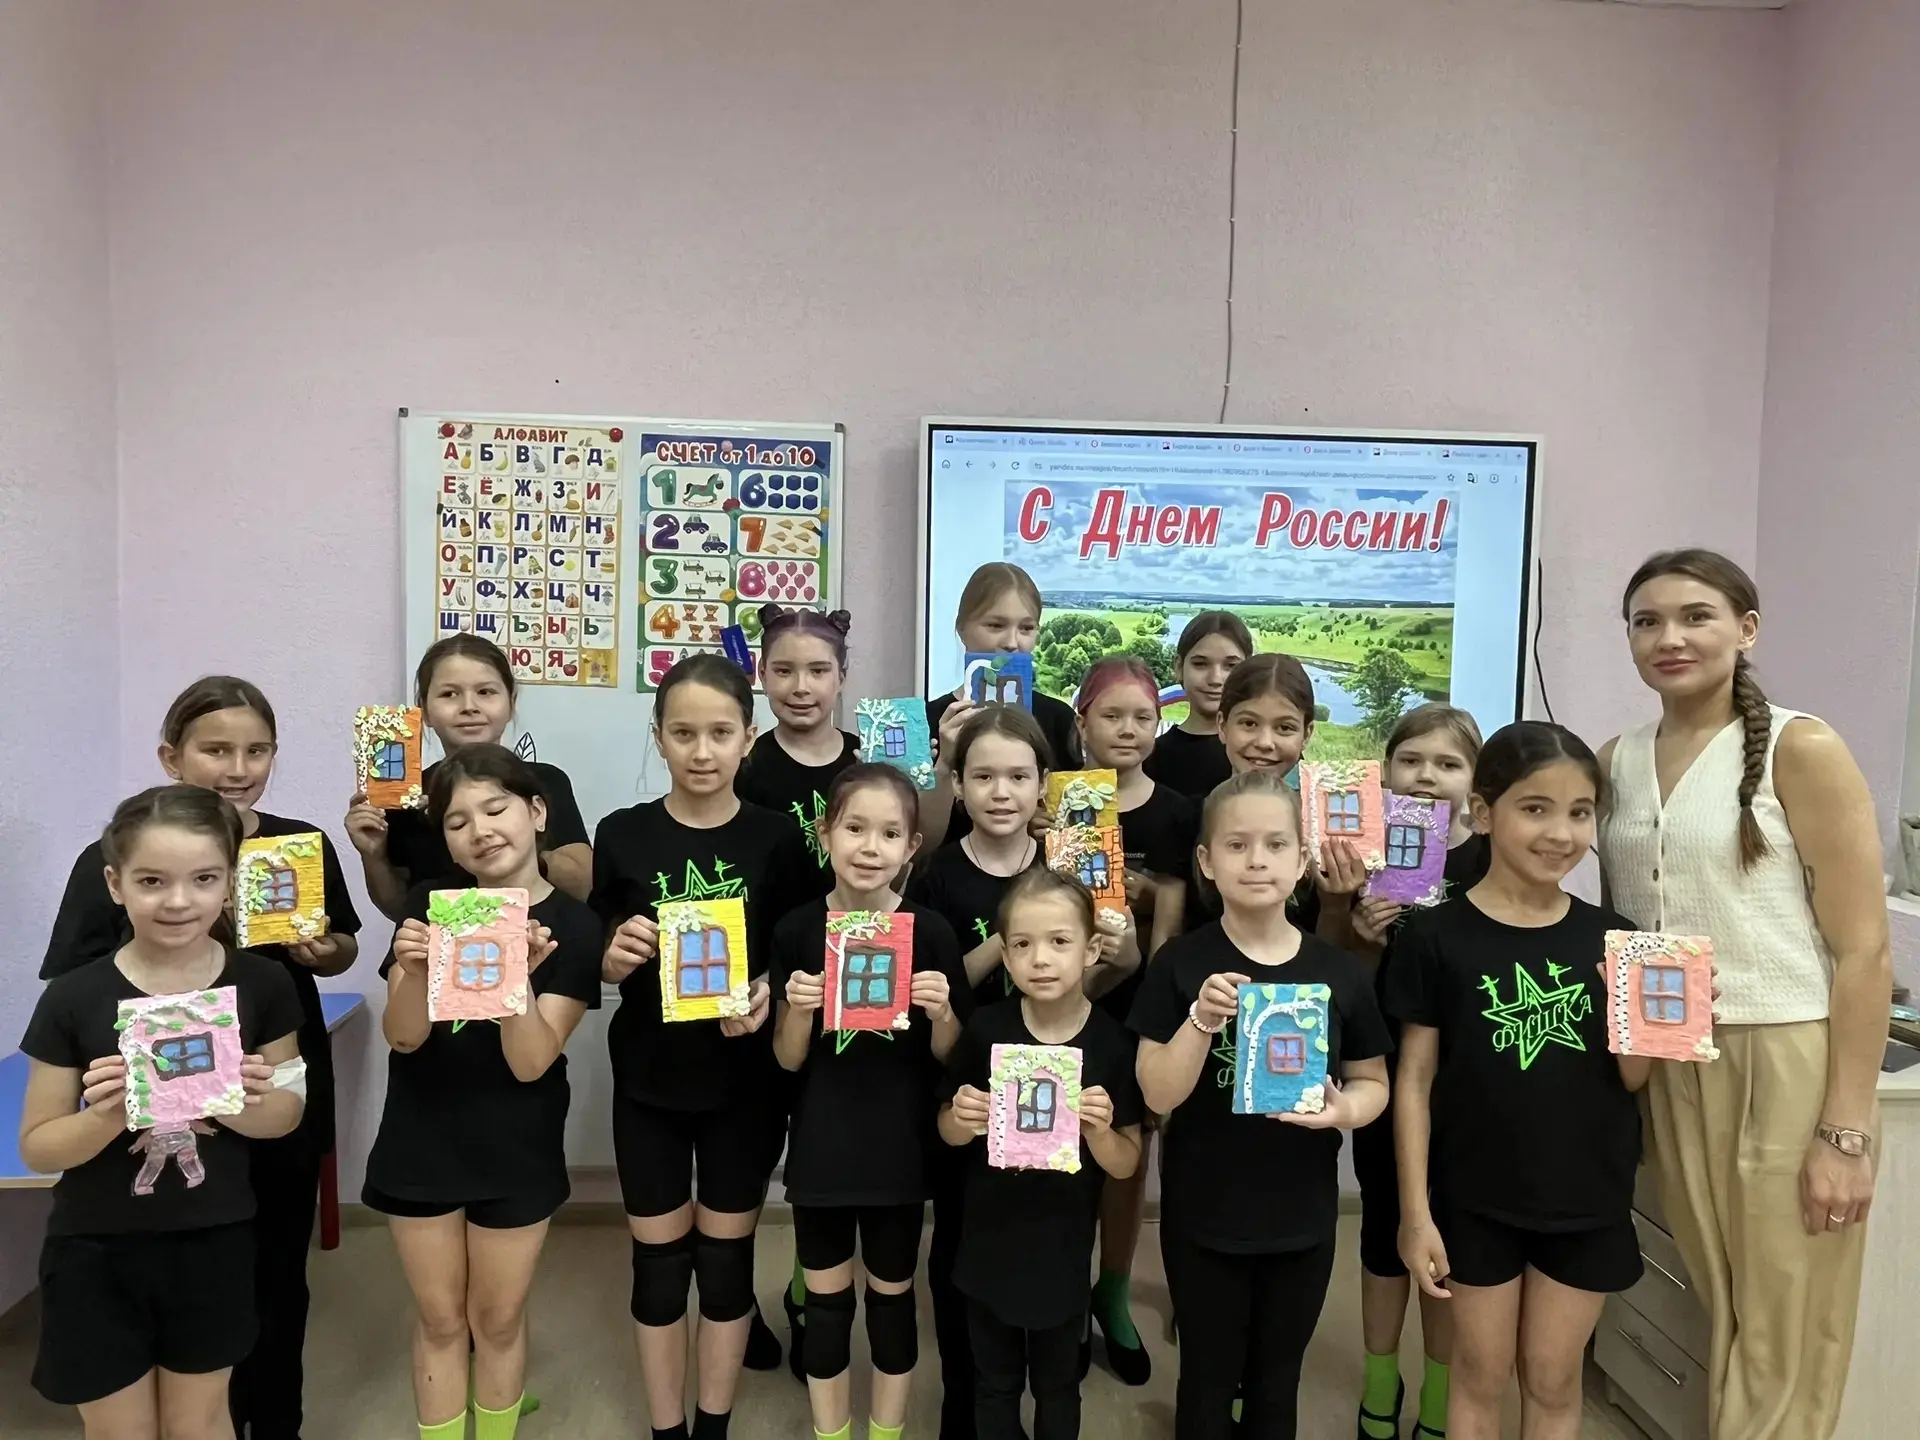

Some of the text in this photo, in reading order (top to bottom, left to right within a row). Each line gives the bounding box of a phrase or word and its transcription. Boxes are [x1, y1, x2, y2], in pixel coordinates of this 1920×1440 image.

[494, 427, 568, 443] АЛФАВИТ
[444, 442, 603, 466] А Б В Г Д
[656, 441, 717, 464] СЧЕТ
[745, 443, 757, 464] 1
[787, 445, 816, 466] 10
[444, 475, 601, 500] Е Ё Ж З И
[652, 469, 767, 508] 1 6
[442, 508, 603, 534] Й К Л М Н
[652, 513, 767, 553] 2 7
[1018, 486, 1451, 561] С Днем России!
[441, 543, 601, 568] О П Р С Т
[442, 578, 600, 603] У Ф Х Ц Ч
[650, 558, 767, 598] 3 8
[440, 612, 600, 635] Ш Щ Ъ Ы Ь
[650, 603, 764, 642] 4 9
[511, 648, 564, 668] Ю Я
[649, 650, 674, 686] 5
